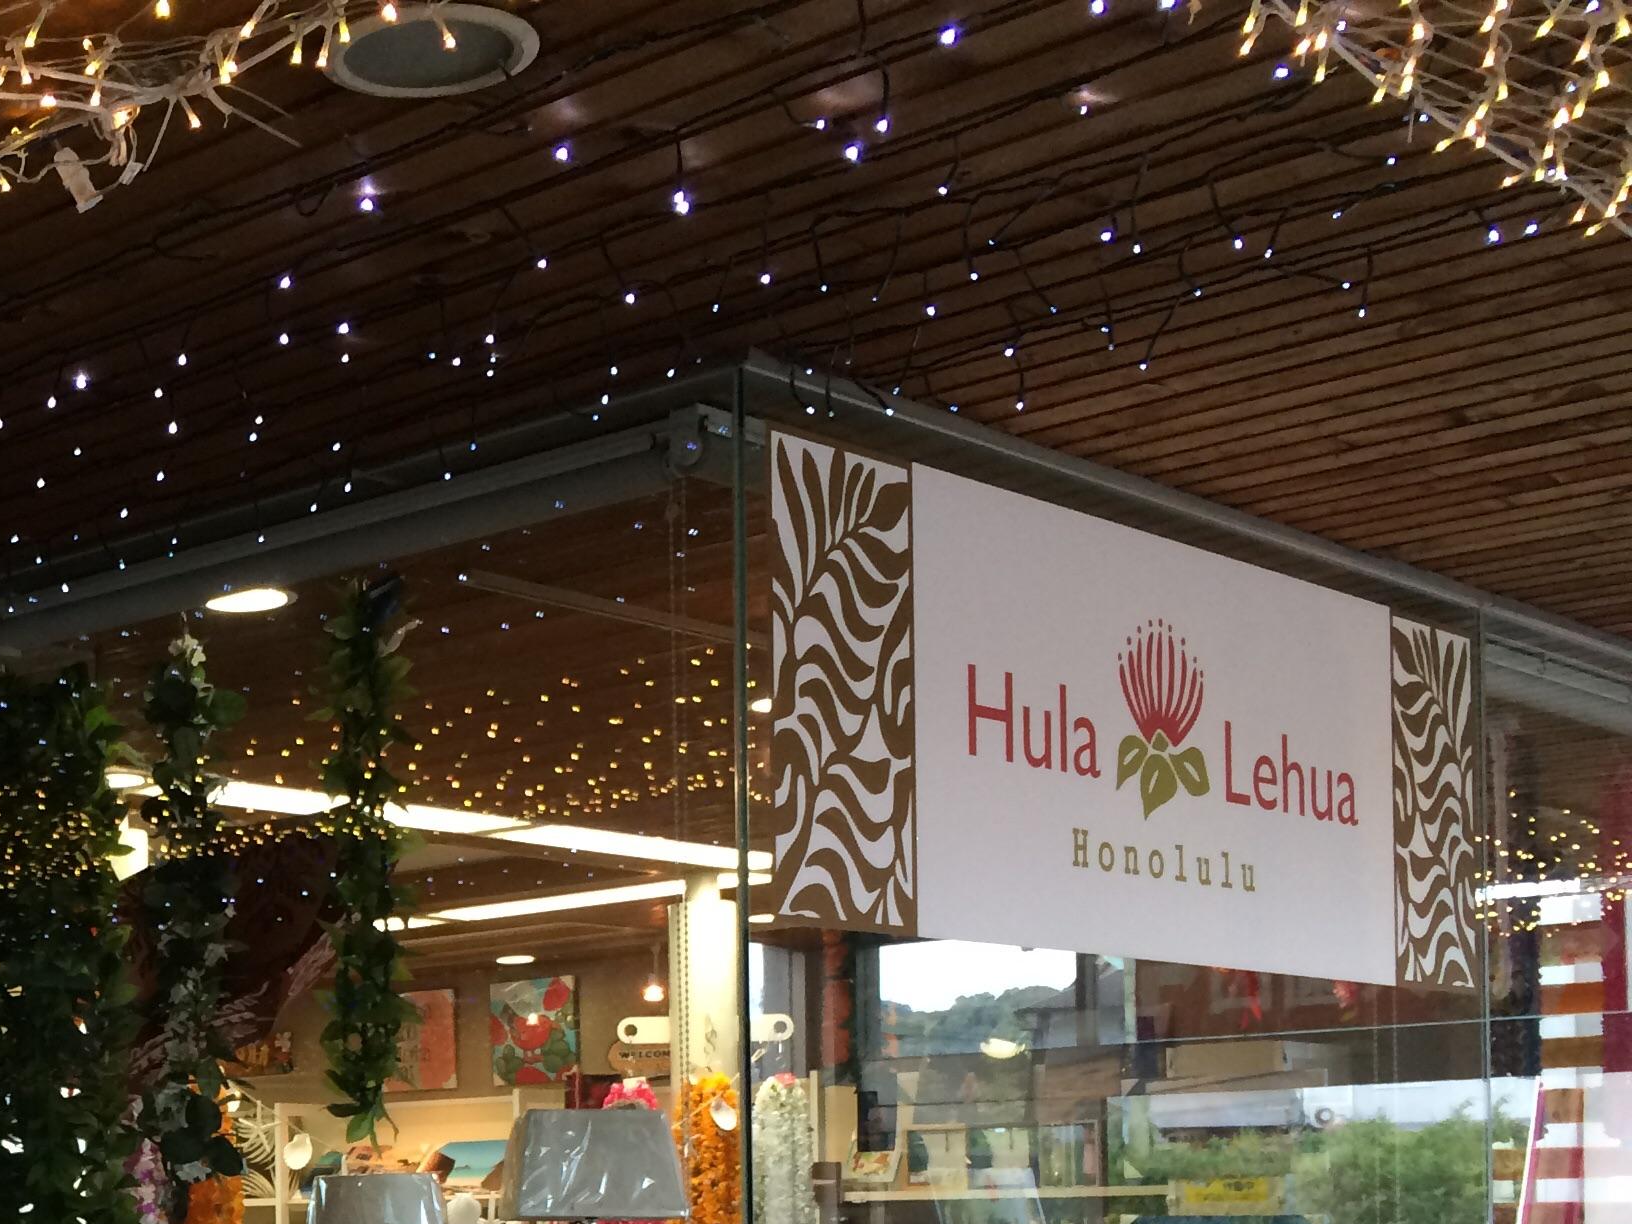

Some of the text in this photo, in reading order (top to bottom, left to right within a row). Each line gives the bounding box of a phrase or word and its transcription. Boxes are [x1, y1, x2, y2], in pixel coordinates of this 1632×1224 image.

[967, 664, 1360, 827] Hula Lehua
[1072, 827, 1257, 893] Honolulu
[619, 1050, 670, 1058] WELCOM
